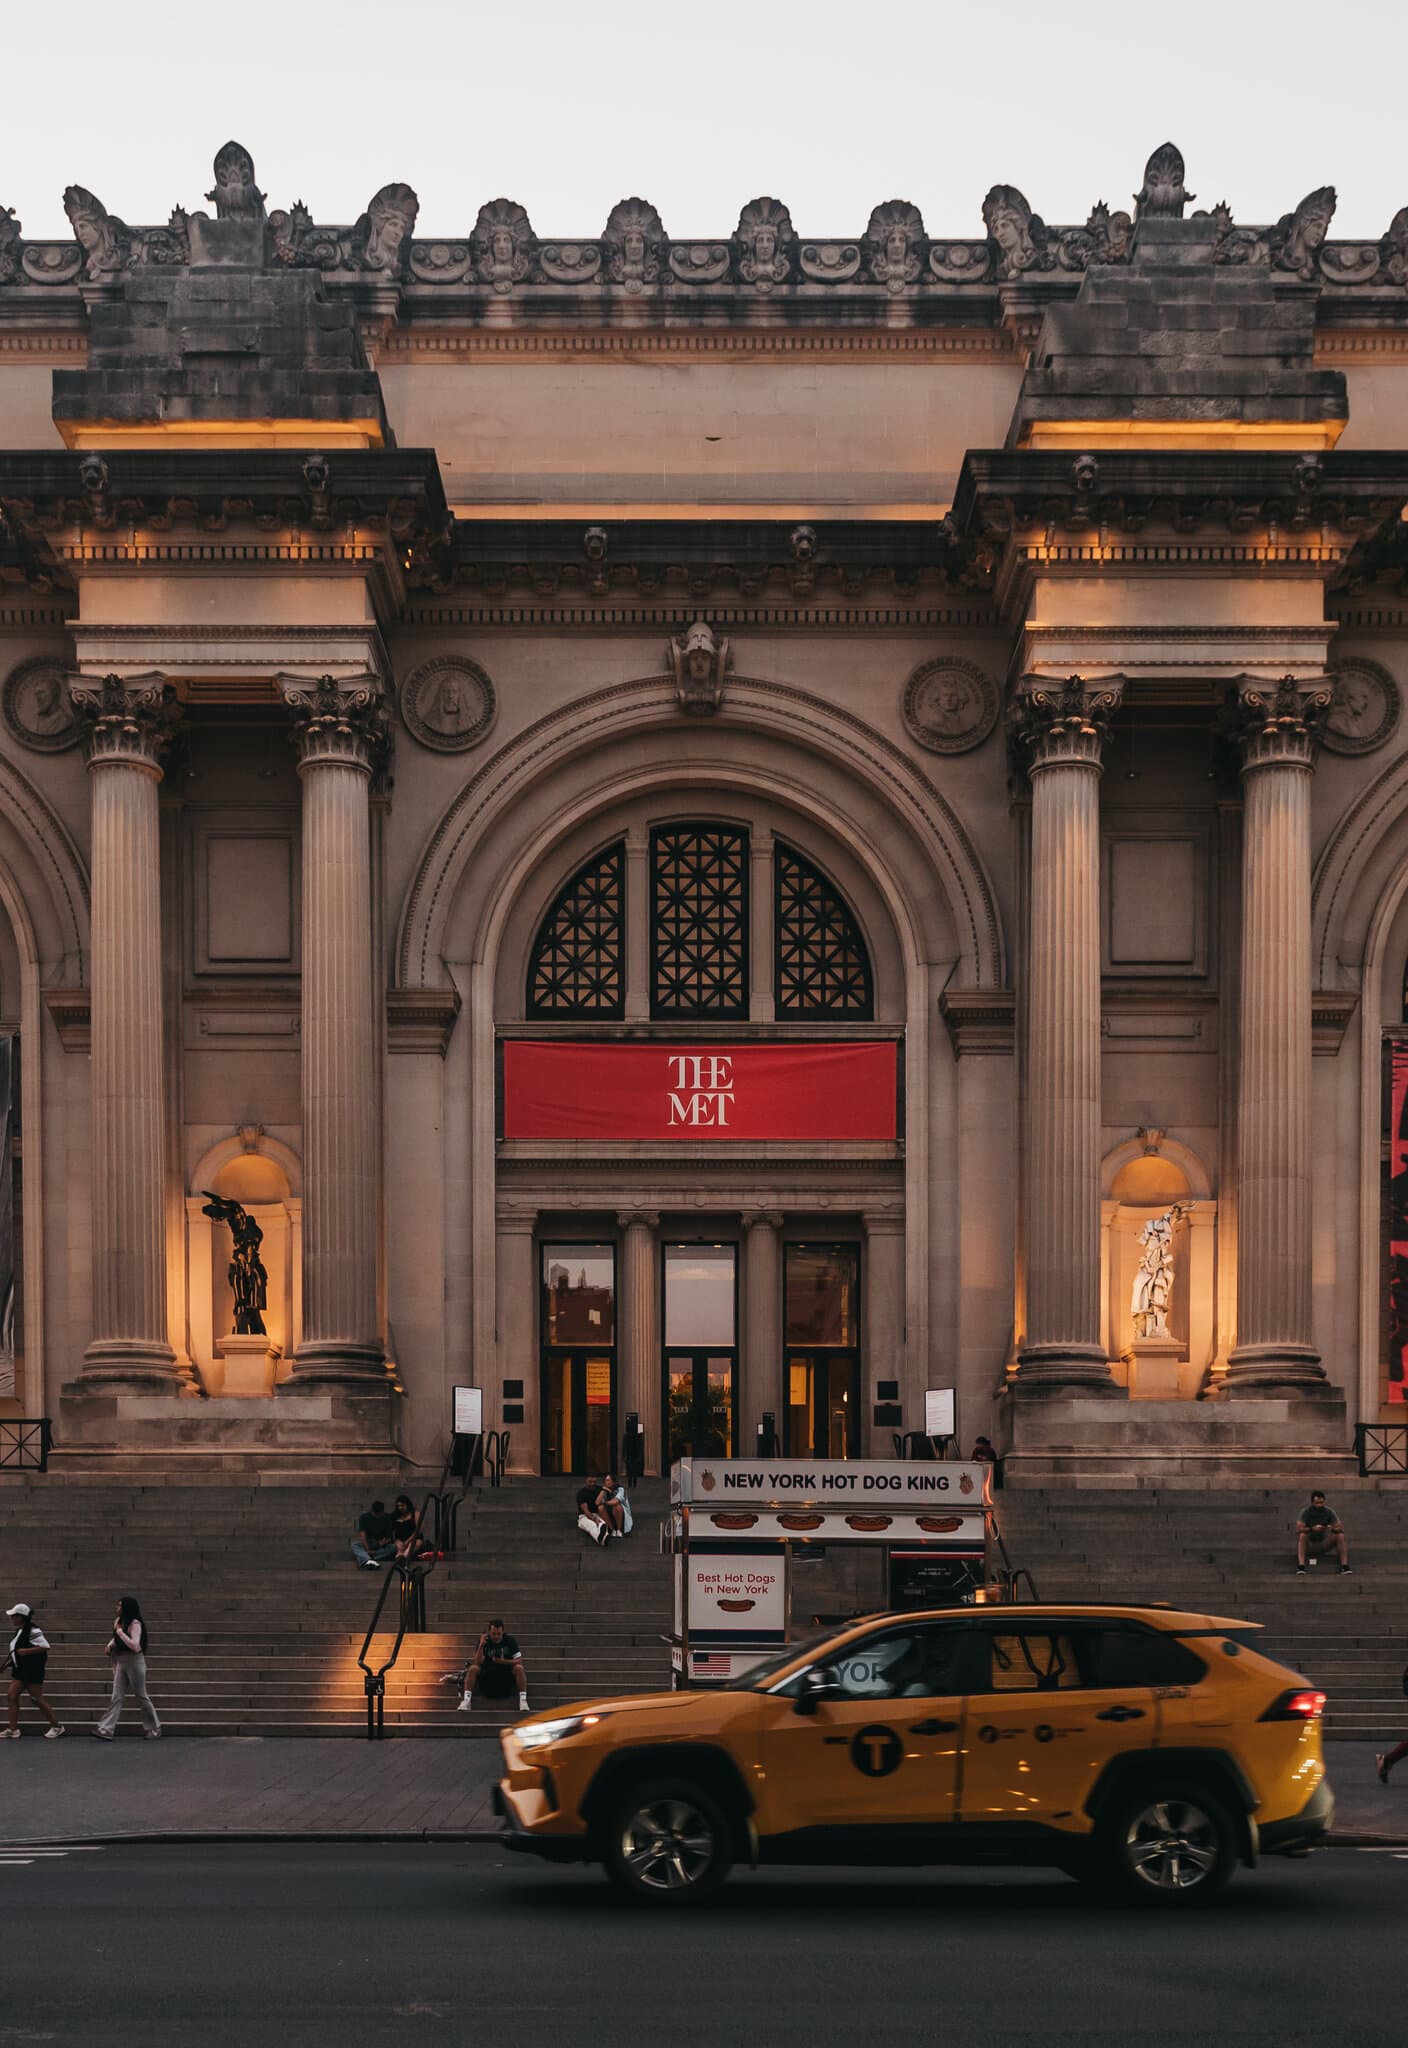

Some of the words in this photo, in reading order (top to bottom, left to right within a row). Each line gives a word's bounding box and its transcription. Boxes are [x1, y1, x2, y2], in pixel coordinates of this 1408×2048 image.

[667, 1055, 734, 1089] THE
[666, 1092, 736, 1126] MET
[723, 1473, 764, 1489] NEW
[768, 1473, 816, 1489] YORK
[822, 1474, 858, 1490] HOT
[863, 1474, 902, 1490] DOG
[907, 1475, 950, 1491] KING
[697, 1573, 720, 1583] Best
[724, 1573, 744, 1583] Hot
[747, 1573, 776, 1585] Dogs
[704, 1584, 713, 1594] in
[716, 1585, 741, 1594] New
[744, 1585, 769, 1594] York
[862, 1735, 893, 1771] T
